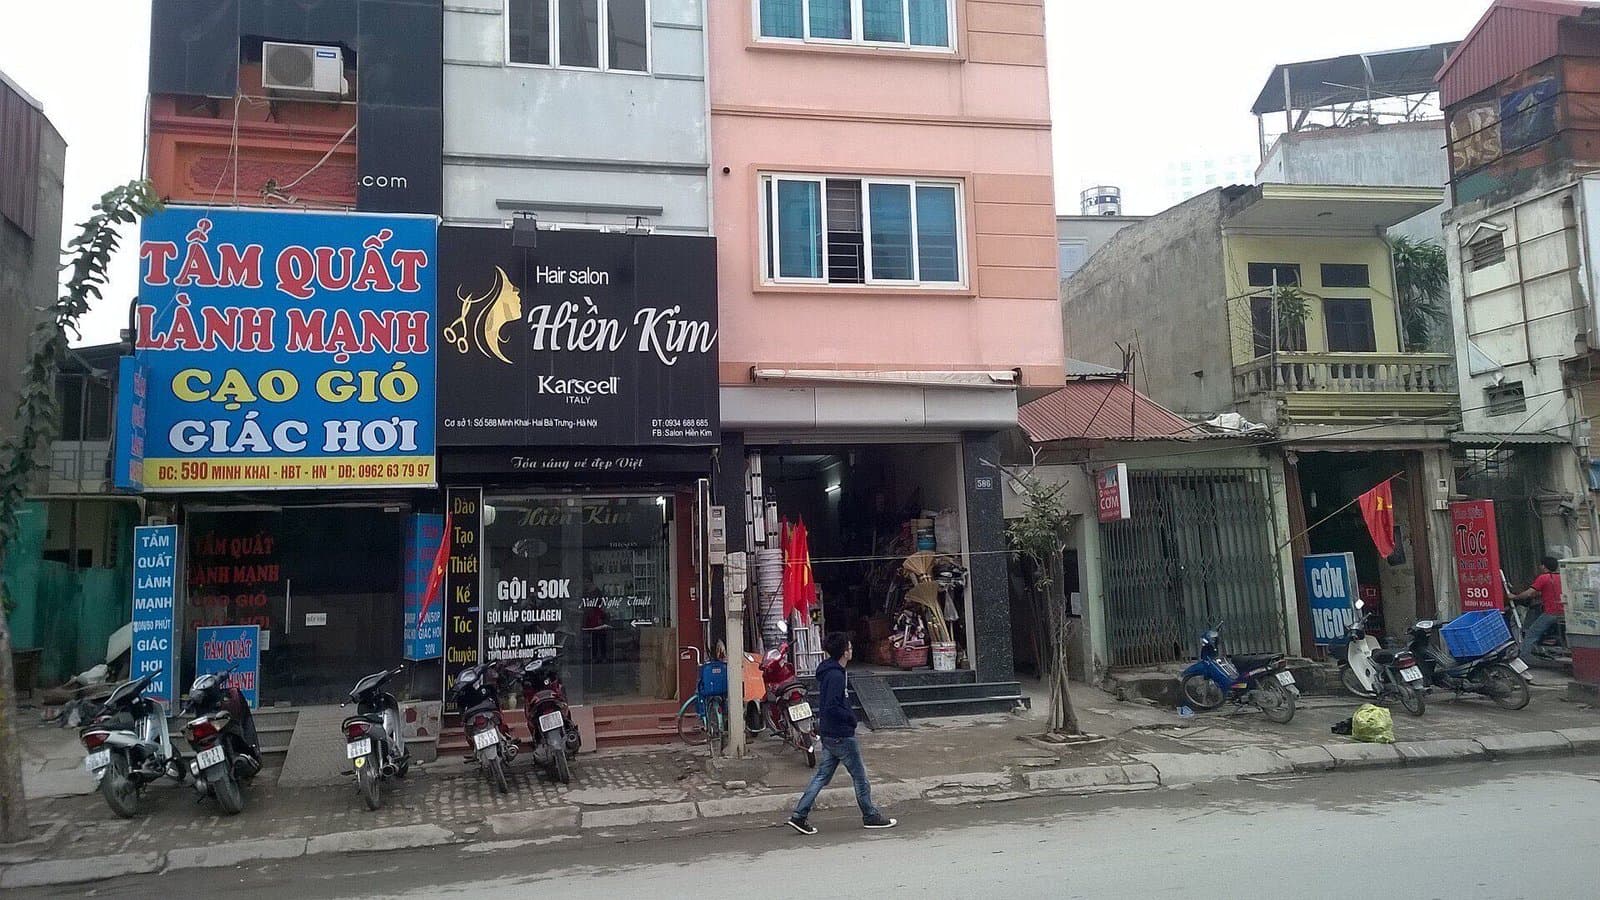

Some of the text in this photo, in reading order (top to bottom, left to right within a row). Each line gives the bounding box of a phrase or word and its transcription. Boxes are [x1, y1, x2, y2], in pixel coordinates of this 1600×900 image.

[140, 218, 427, 299] TẨM QUẤT
[536, 265, 609, 285] Hair salon
[135, 293, 429, 363] LÀNH MẠNH
[528, 297, 717, 366] Hiền Kim
[171, 368, 299, 410] CẠO
[315, 361, 419, 403] GIÓ
[538, 375, 618, 395] Karseell
[566, 396, 591, 404] ITALY
[168, 411, 308, 453] GIÁC
[322, 417, 417, 452] HƠI
[484, 418, 497, 427] 588
[497, 418, 513, 427] Minh
[532, 418, 543, 427] Hai
[576, 418, 586, 427] Hà
[586, 418, 598, 429] Nội
[700, 429, 713, 437] Kim
[181, 462, 208, 480] 590
[212, 465, 241, 480] MINH
[244, 465, 270, 479] KHAI
[281, 465, 301, 478] HBT
[312, 464, 328, 478] HN
[358, 464, 383, 478] 0962
[386, 463, 399, 477] 63
[401, 463, 415, 477] 79
[417, 463, 430, 477] 97
[454, 497, 475, 514] Đào
[454, 526, 474, 548] Tạo
[138, 551, 172, 568] QUẤT
[450, 553, 479, 574] Thiết
[138, 574, 171, 589] LÀNH
[1311, 561, 1345, 598] CƠM
[456, 583, 471, 603] Kế
[497, 576, 527, 603] GỘI
[537, 579, 570, 599] 30K
[1467, 588, 1489, 598] 580
[135, 597, 172, 612] MẠNH
[453, 616, 472, 633] Tóc
[487, 606, 562, 625] GỘI HẤP COLLAGEN
[137, 636, 168, 651] GIÁC
[225, 630, 252, 664] QUẤT
[488, 631, 506, 649] UỐN
[525, 630, 555, 647] NHUỘM
[141, 659, 162, 672] HƠI
[447, 646, 477, 666] Chuyên
